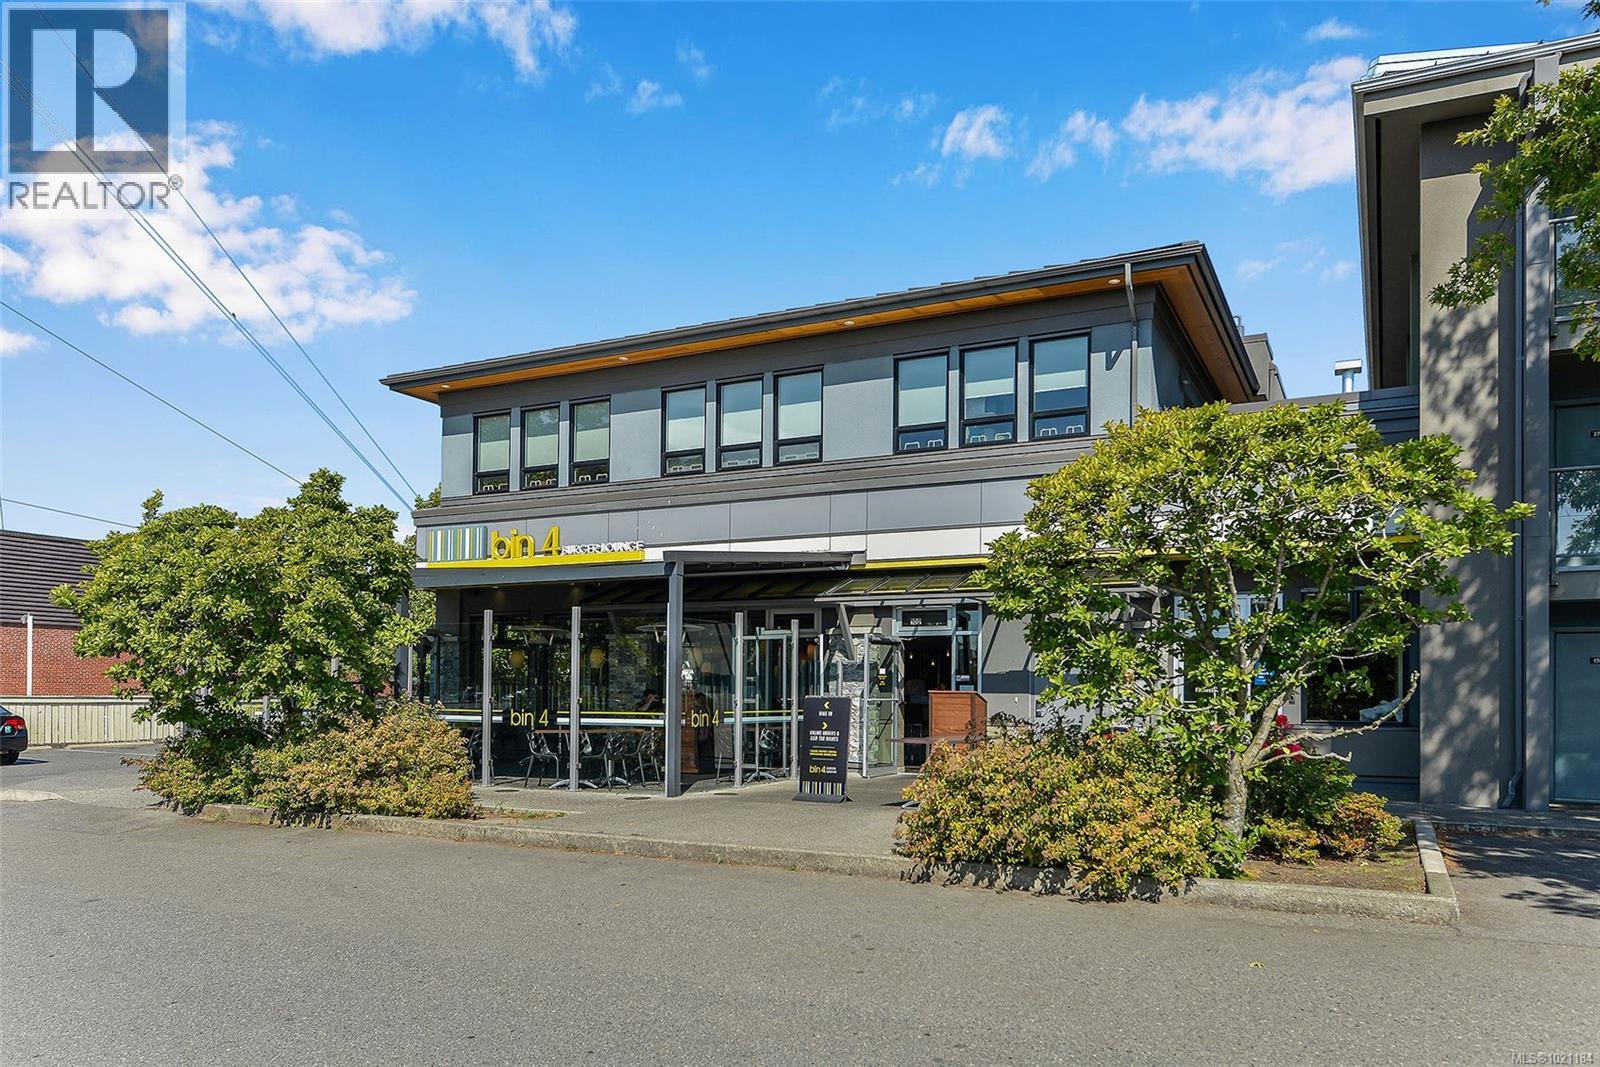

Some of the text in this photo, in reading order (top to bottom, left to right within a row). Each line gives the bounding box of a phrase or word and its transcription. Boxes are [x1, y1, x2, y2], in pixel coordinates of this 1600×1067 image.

[491, 528, 535, 560] bin
[542, 525, 561, 557] 4
[510, 709, 549, 727] bin 4
[691, 709, 720, 728] bin 4
[809, 765, 821, 774] bin
[821, 765, 826, 774] 4
